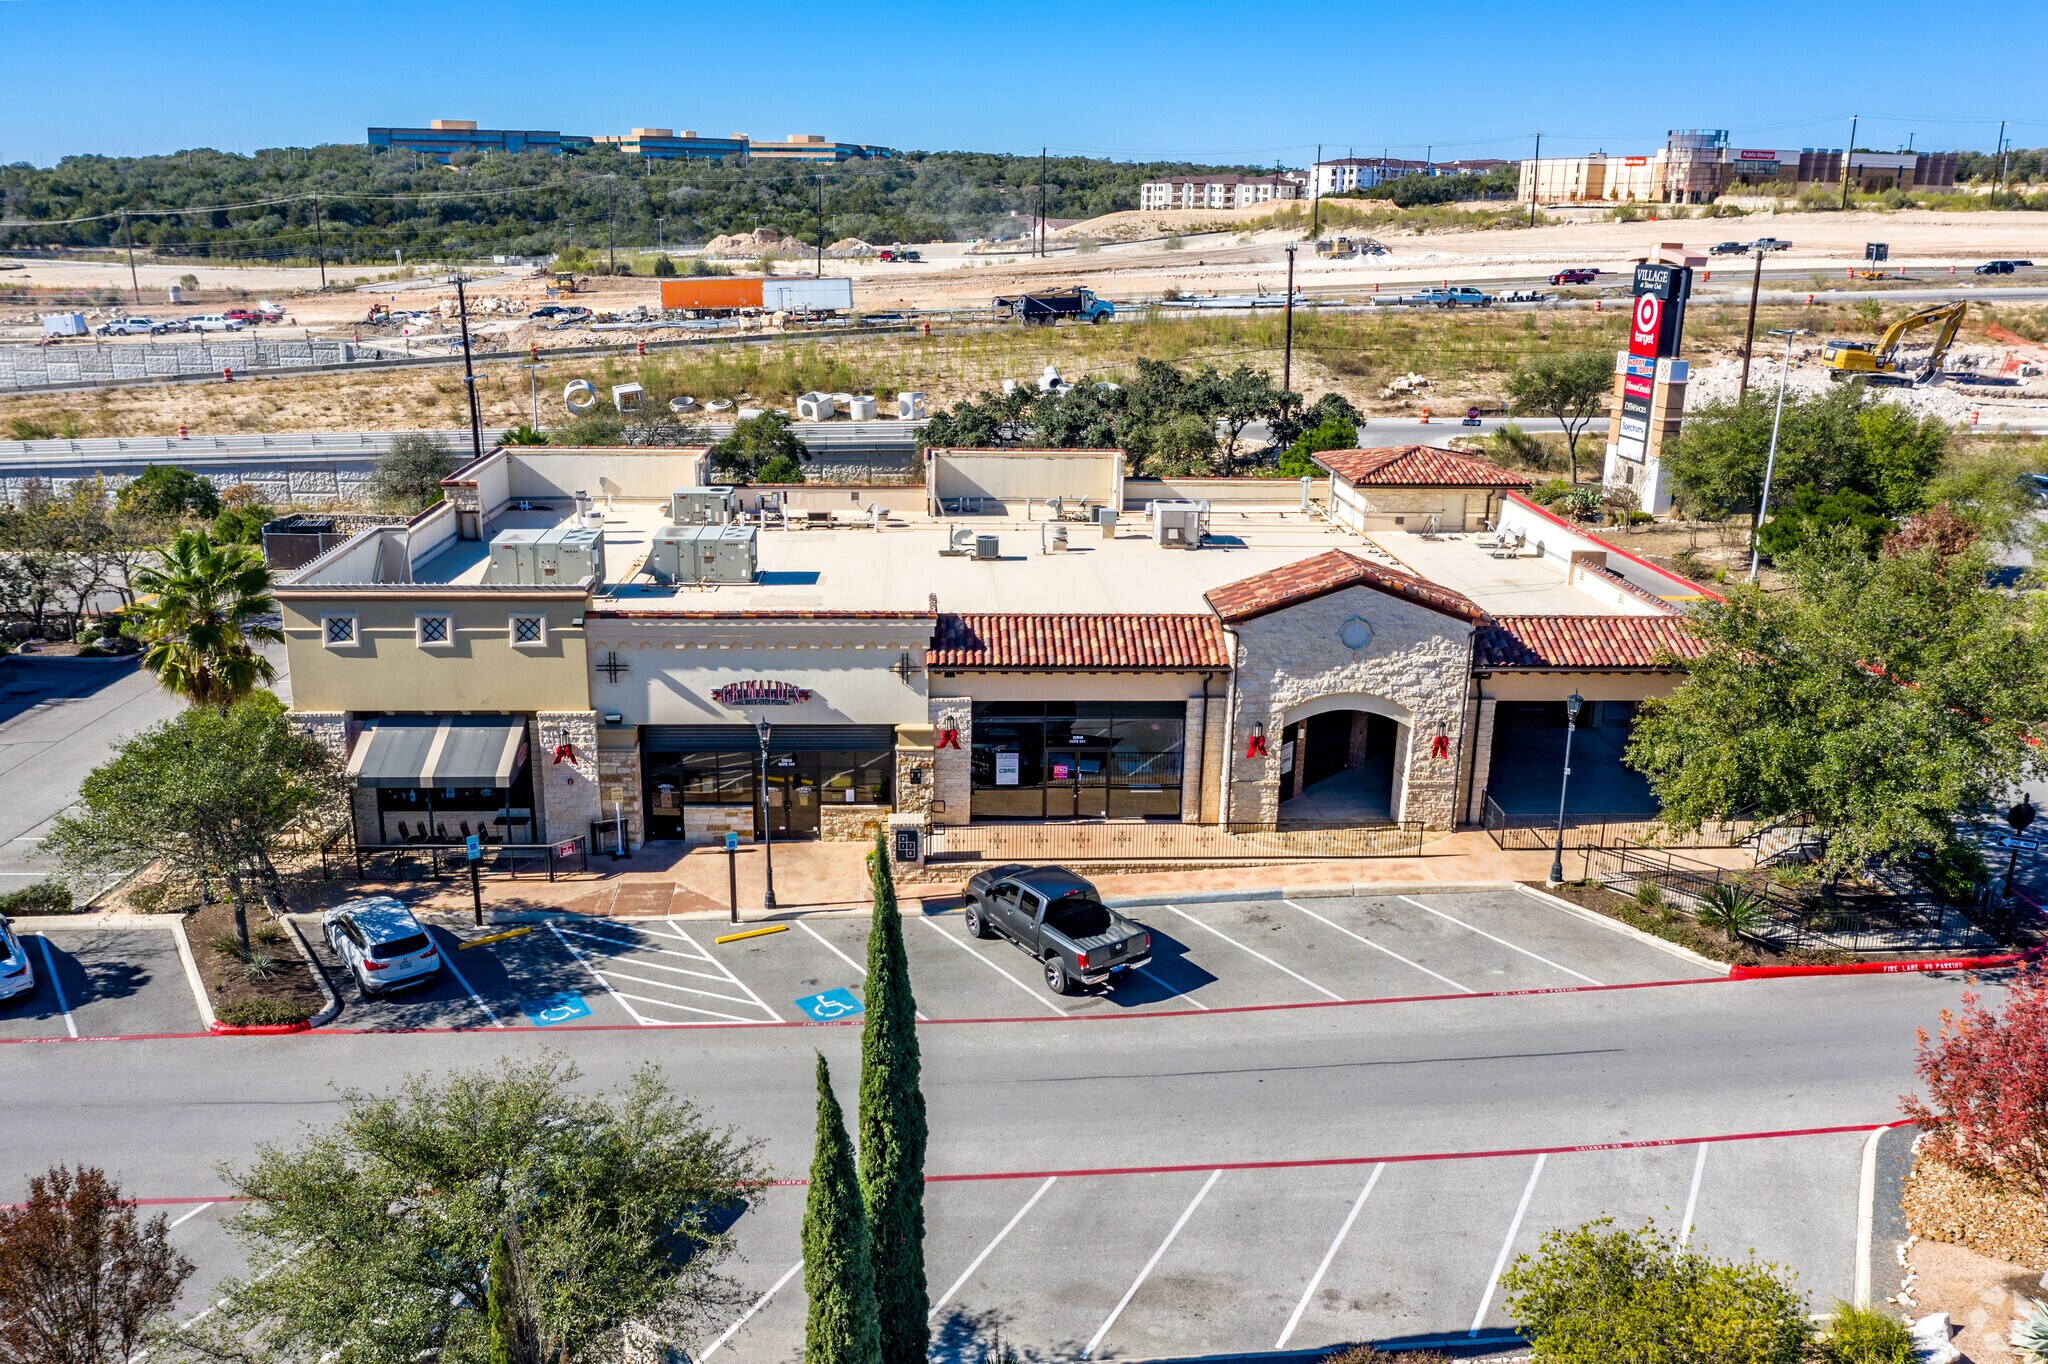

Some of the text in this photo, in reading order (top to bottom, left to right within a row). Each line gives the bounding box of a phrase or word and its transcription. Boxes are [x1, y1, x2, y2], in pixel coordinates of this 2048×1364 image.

[1637, 269, 1668, 283] VILLAGE
[1635, 331, 1654, 346] target
[1629, 359, 1646, 367] HOBBY
[1636, 366, 1653, 375] LOBBY
[1626, 381, 1651, 394] HomeGoods
[721, 680, 800, 705] GRIMALDI'S
[1883, 965, 1898, 973] FIRE
